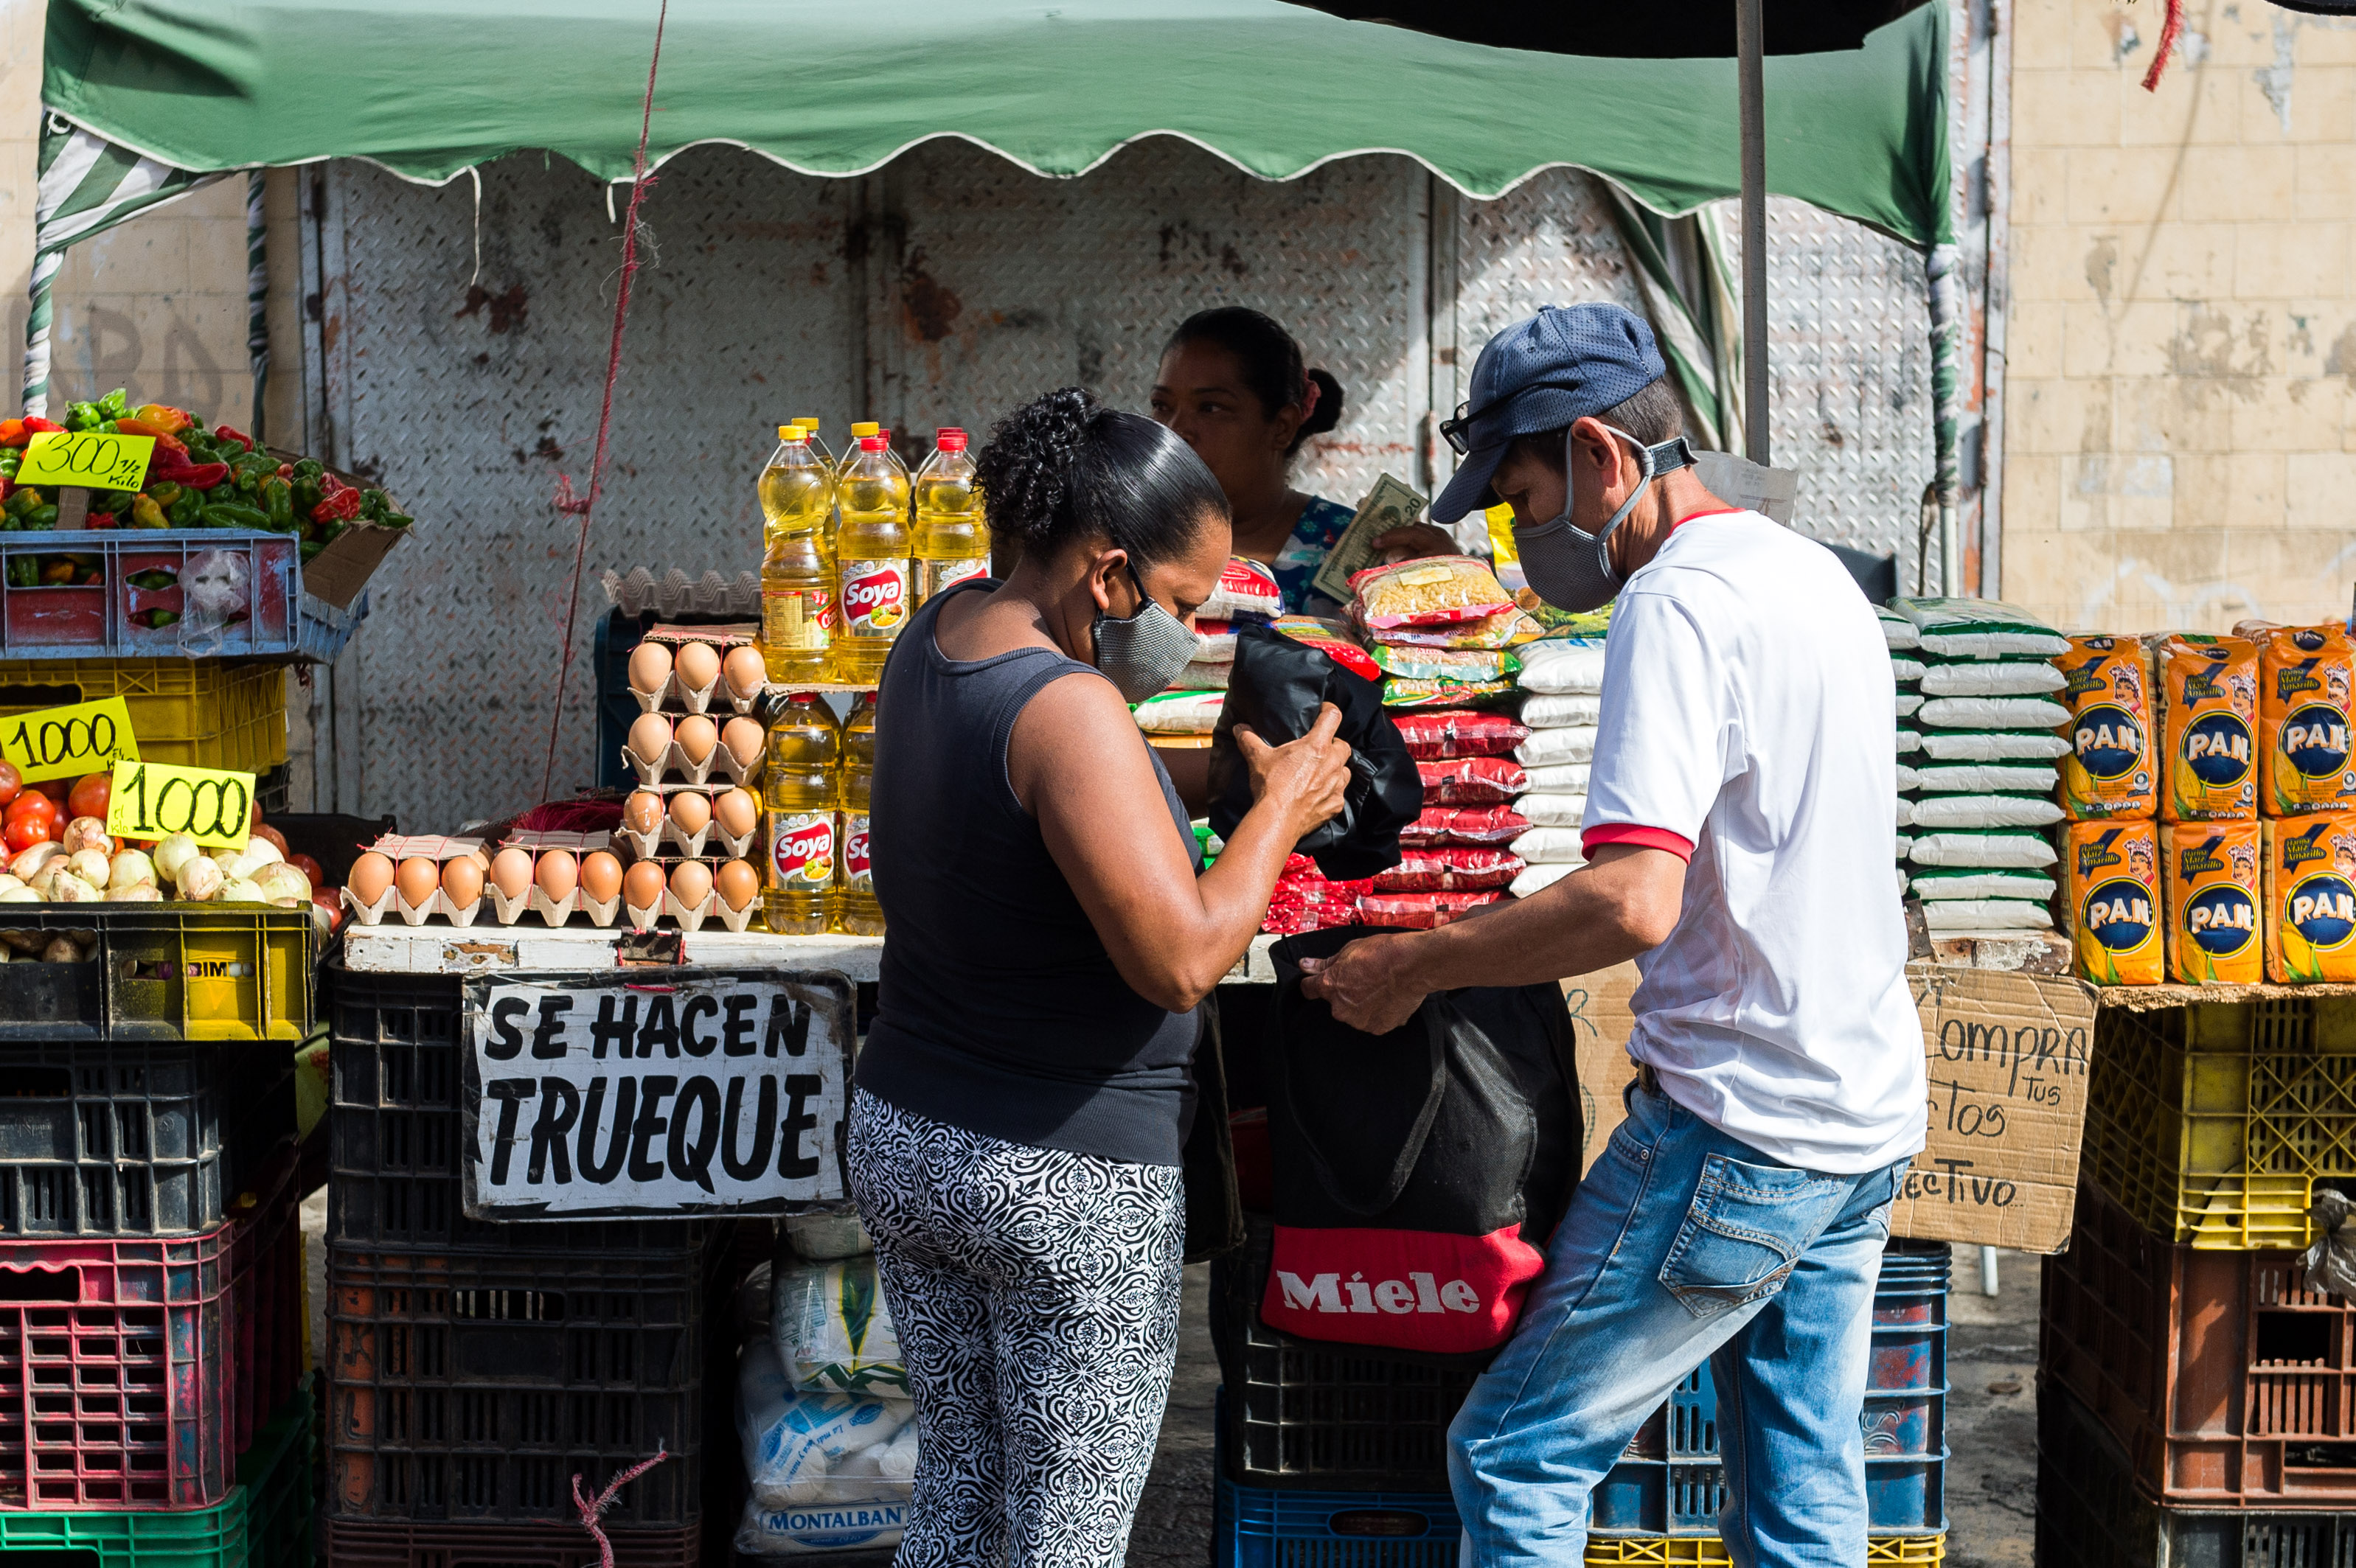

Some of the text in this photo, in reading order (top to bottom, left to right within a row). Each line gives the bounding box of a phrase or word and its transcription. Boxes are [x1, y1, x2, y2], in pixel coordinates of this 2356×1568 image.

[37, 432, 120, 475] 300
[1405, 498, 1421, 518] 20
[846, 581, 900, 607] Soya
[9, 714, 117, 769] 1000
[778, 834, 830, 860] Soya
[484, 994, 812, 1060] SE HACEN
[486, 1073, 823, 1195] TRUEQUE
[1276, 1269, 1480, 1314] Miele
[768, 1505, 902, 1530] MONTALBAN
